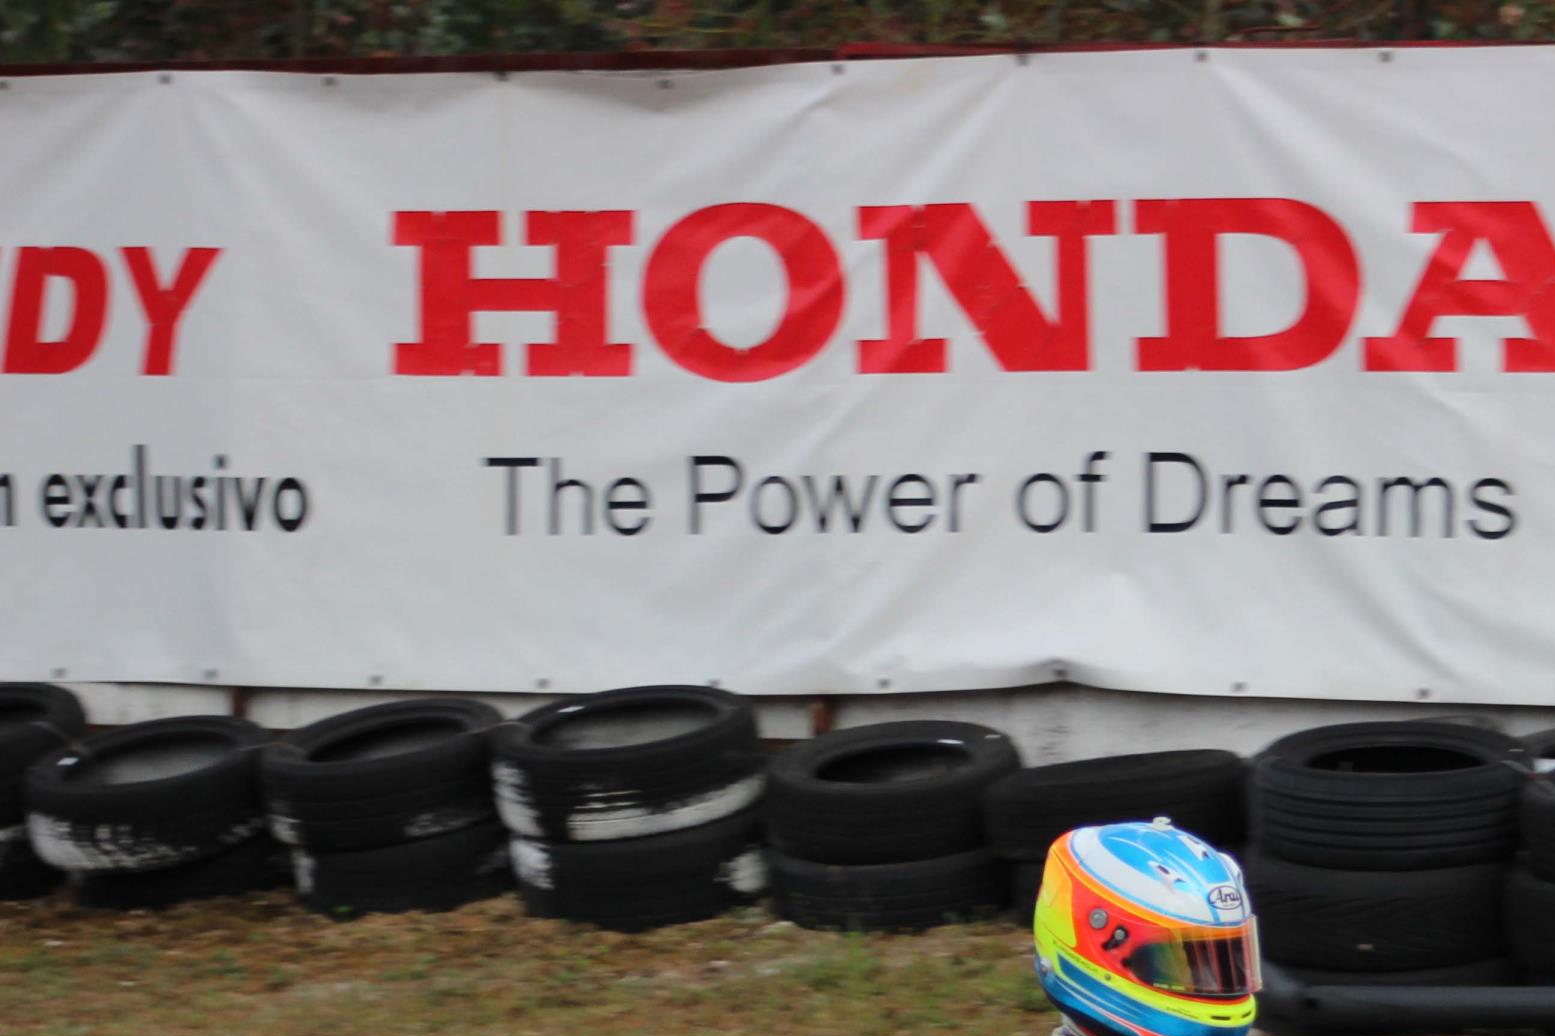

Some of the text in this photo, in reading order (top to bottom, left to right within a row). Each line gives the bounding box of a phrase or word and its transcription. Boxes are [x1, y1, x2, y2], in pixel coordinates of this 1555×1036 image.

[0, 246, 223, 376] DY
[40, 444, 310, 532] exclusivo
[481, 450, 1517, 539] The Power of Dreams
